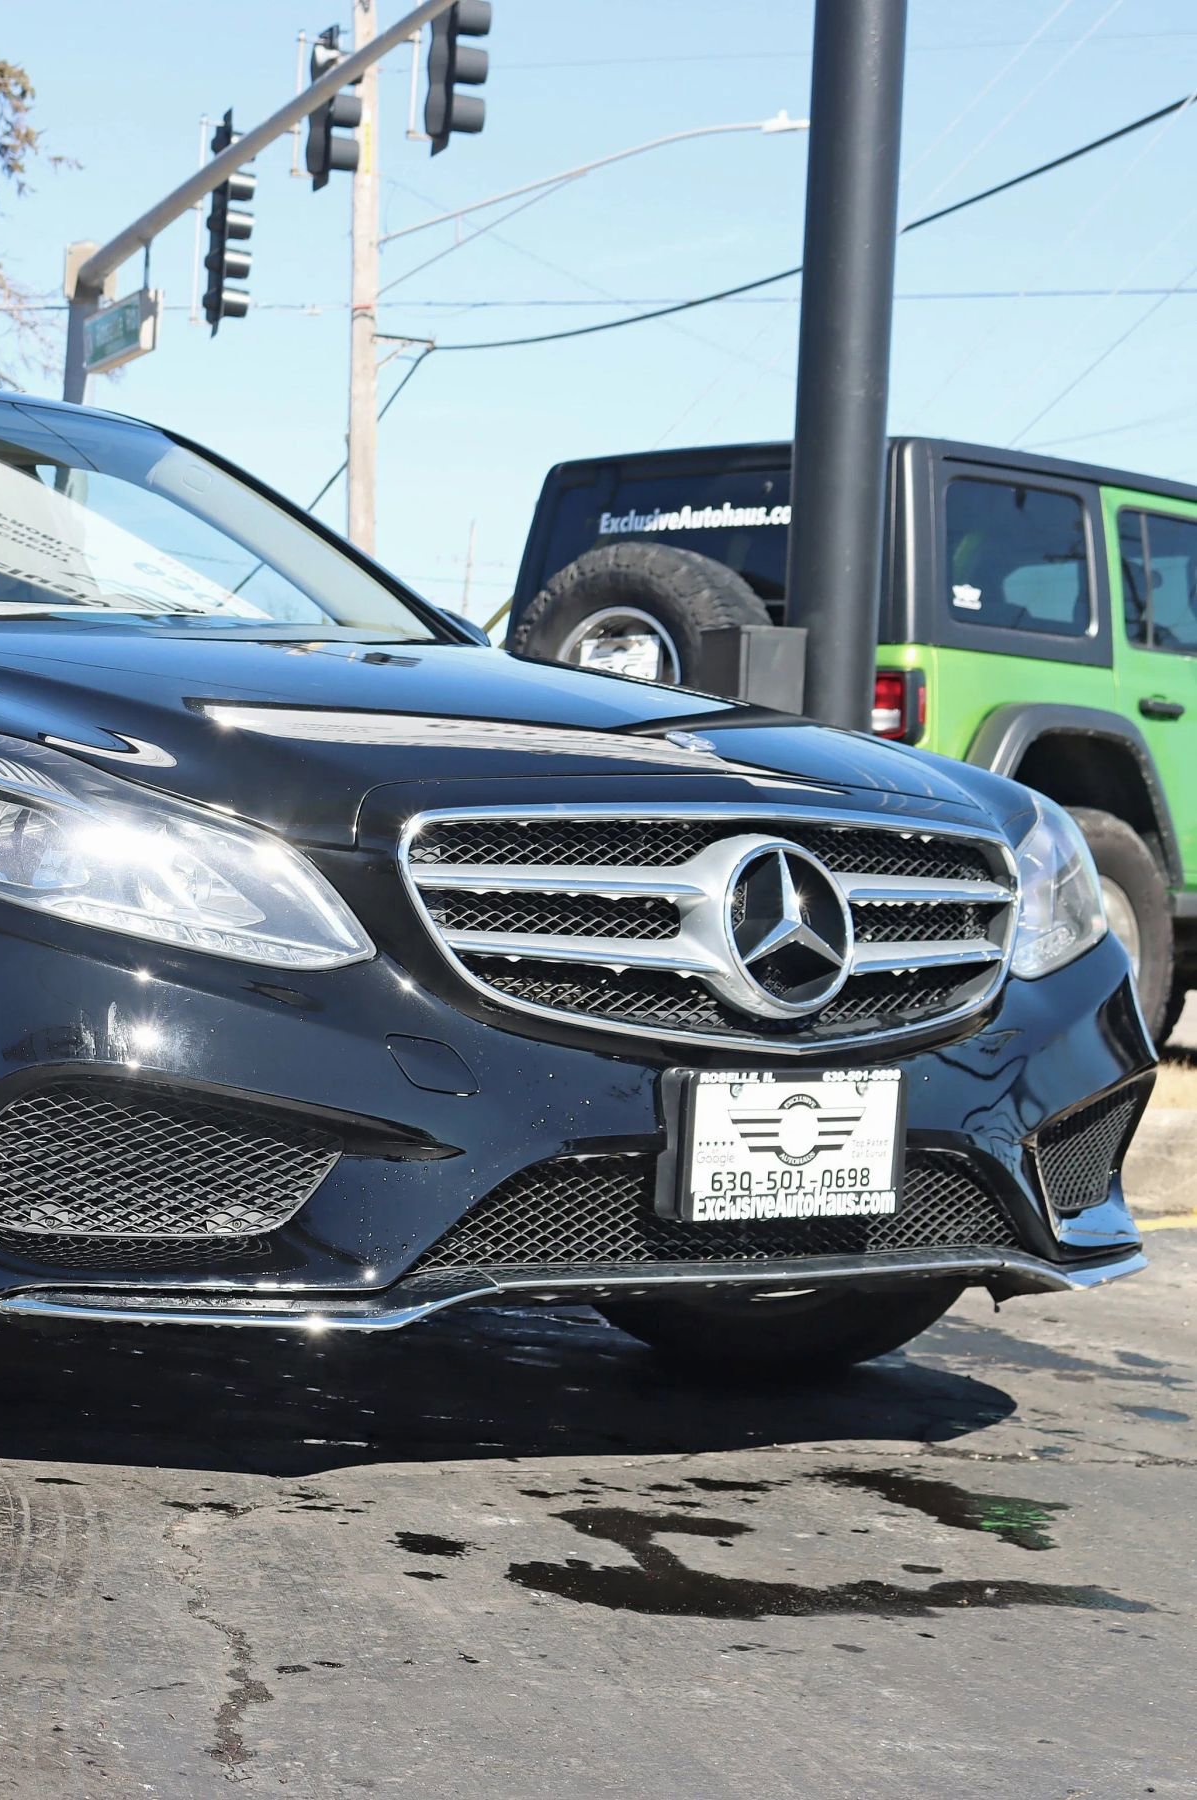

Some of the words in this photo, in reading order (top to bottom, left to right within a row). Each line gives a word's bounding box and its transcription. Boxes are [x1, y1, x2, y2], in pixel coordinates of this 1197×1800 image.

[783, 1095, 817, 1109] EXCLUSIVE
[696, 1151, 735, 1167] Google
[779, 1150, 816, 1166] AUTOHAUS
[711, 1167, 871, 1192] 630-501-0698
[692, 1187, 896, 1222] ExclusiveAutoHaus.com
